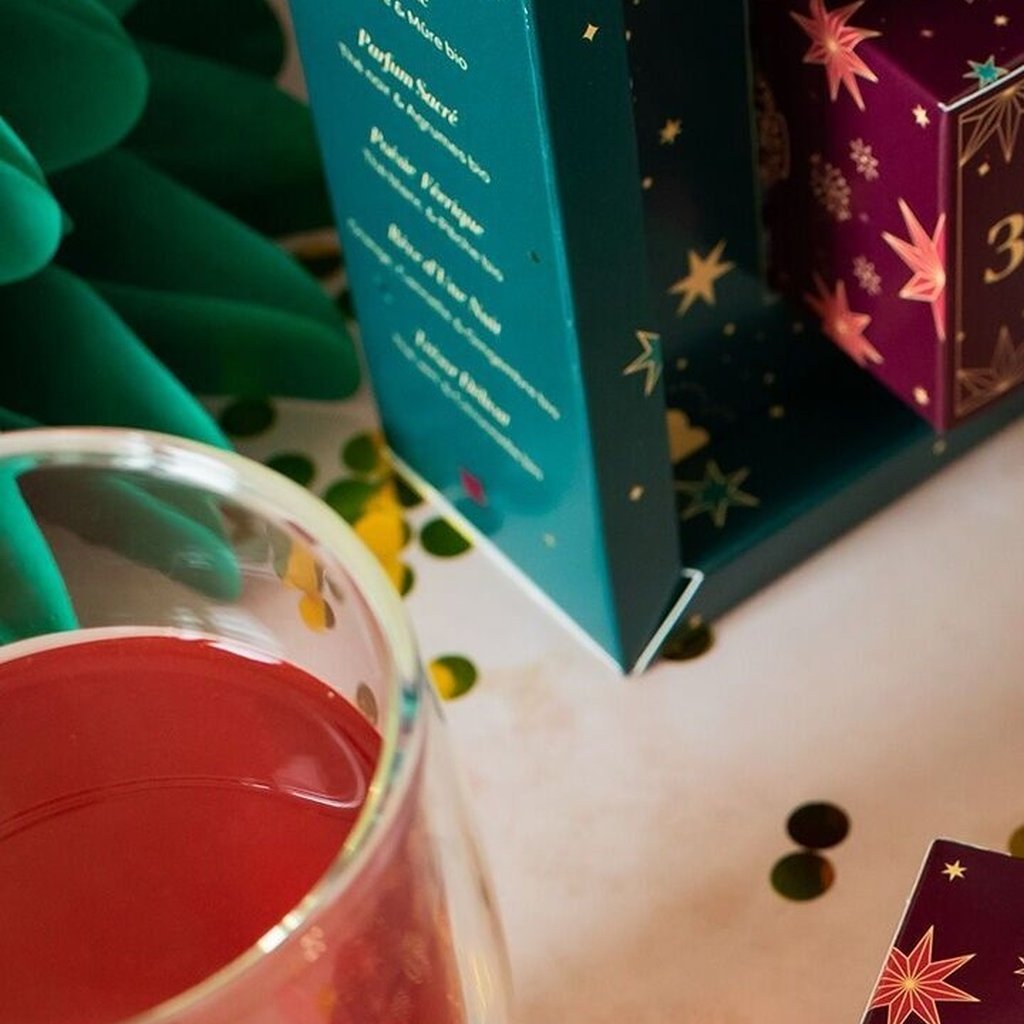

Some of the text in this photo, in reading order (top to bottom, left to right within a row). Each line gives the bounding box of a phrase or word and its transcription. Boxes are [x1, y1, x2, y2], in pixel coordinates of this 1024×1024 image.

[358, 28, 414, 89] Parfum
[415, 79, 459, 127] Sacré
[444, 40, 468, 71] bio
